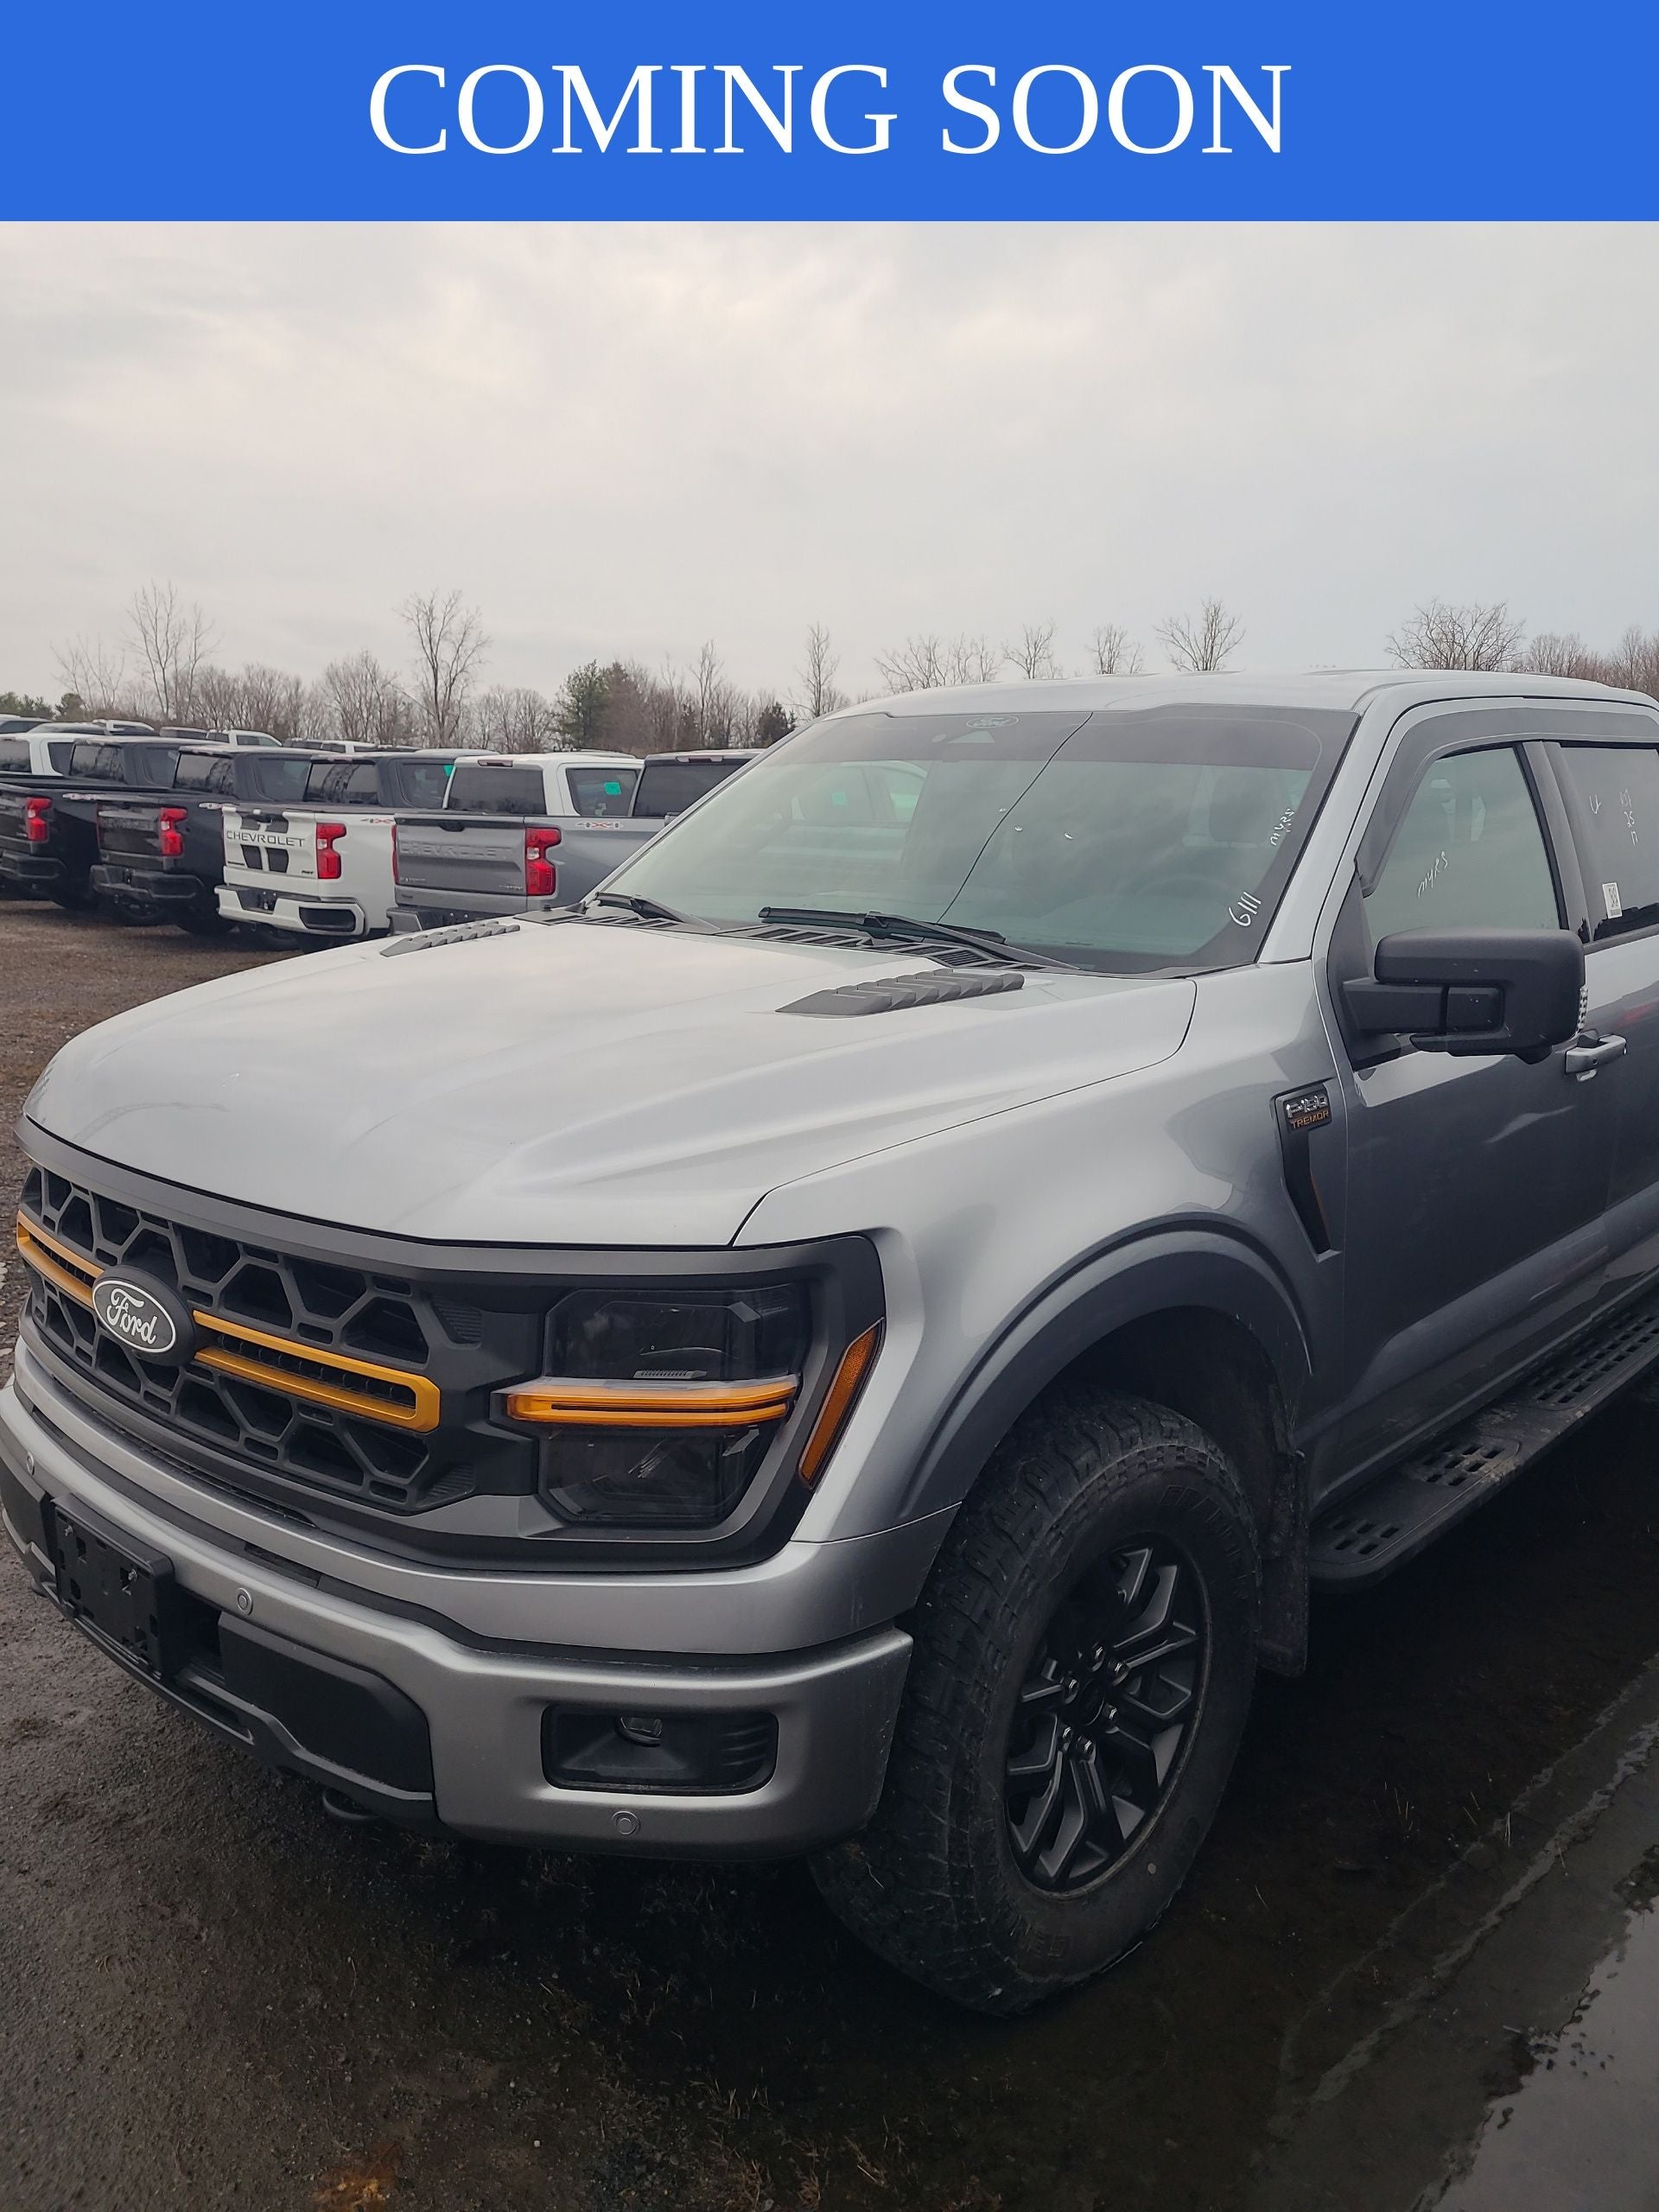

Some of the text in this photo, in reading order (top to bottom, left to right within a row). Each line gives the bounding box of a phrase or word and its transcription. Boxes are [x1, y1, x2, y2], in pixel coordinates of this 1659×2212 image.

[226, 830, 305, 848] CHEVROLET
[1290, 1110, 1330, 1128] TREMOR
[106, 1287, 158, 1344] Ford
